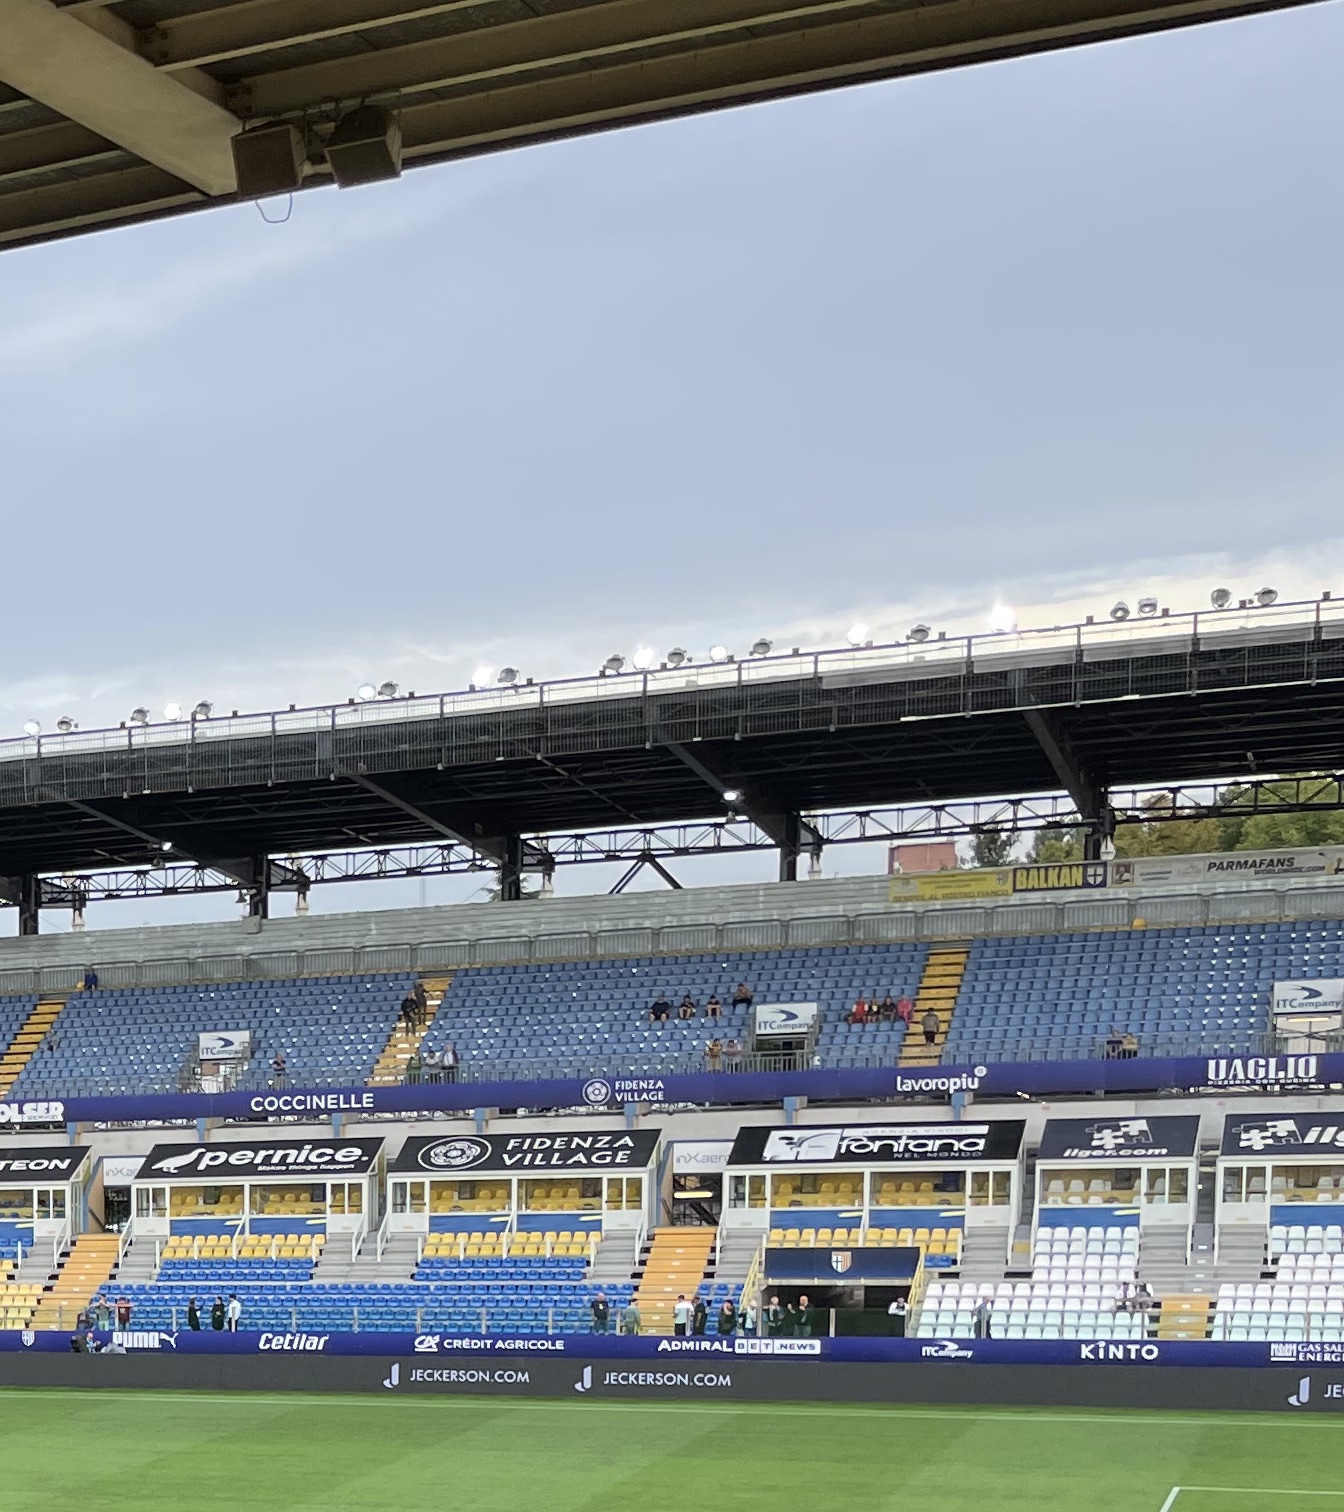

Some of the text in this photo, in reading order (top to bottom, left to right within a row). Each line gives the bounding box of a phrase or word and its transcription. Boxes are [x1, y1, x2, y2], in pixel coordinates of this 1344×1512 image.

[1207, 857, 1295, 873] PARMAFANS
[1015, 865, 1083, 890] BALKAN
[1277, 998, 1341, 1010] ITCompany
[615, 1080, 664, 1090] FIDENZA
[250, 1093, 374, 1111] COCCINELLE
[615, 1091, 664, 1101] VILLAGE
[505, 1135, 635, 1150] FIDENZA
[839, 1137, 986, 1154] fontana
[197, 1144, 370, 1171] pernice.
[501, 1150, 632, 1166] VILLAGE
[113, 1332, 160, 1348] PUMA
[259, 1333, 329, 1351] Cetilar
[443, 1338, 565, 1350] CRÉDIT AGRICOLE
[658, 1338, 733, 1352] ADMIRAL
[737, 1341, 771, 1351] BET
[1298, 1343, 1321, 1352] GAS
[921, 1345, 973, 1359] ITCompany
[409, 1368, 530, 1383] JECKERSON.COM
[603, 1371, 732, 1387] JECKERSON.COM
[1324, 1384, 1344, 1398] JE
